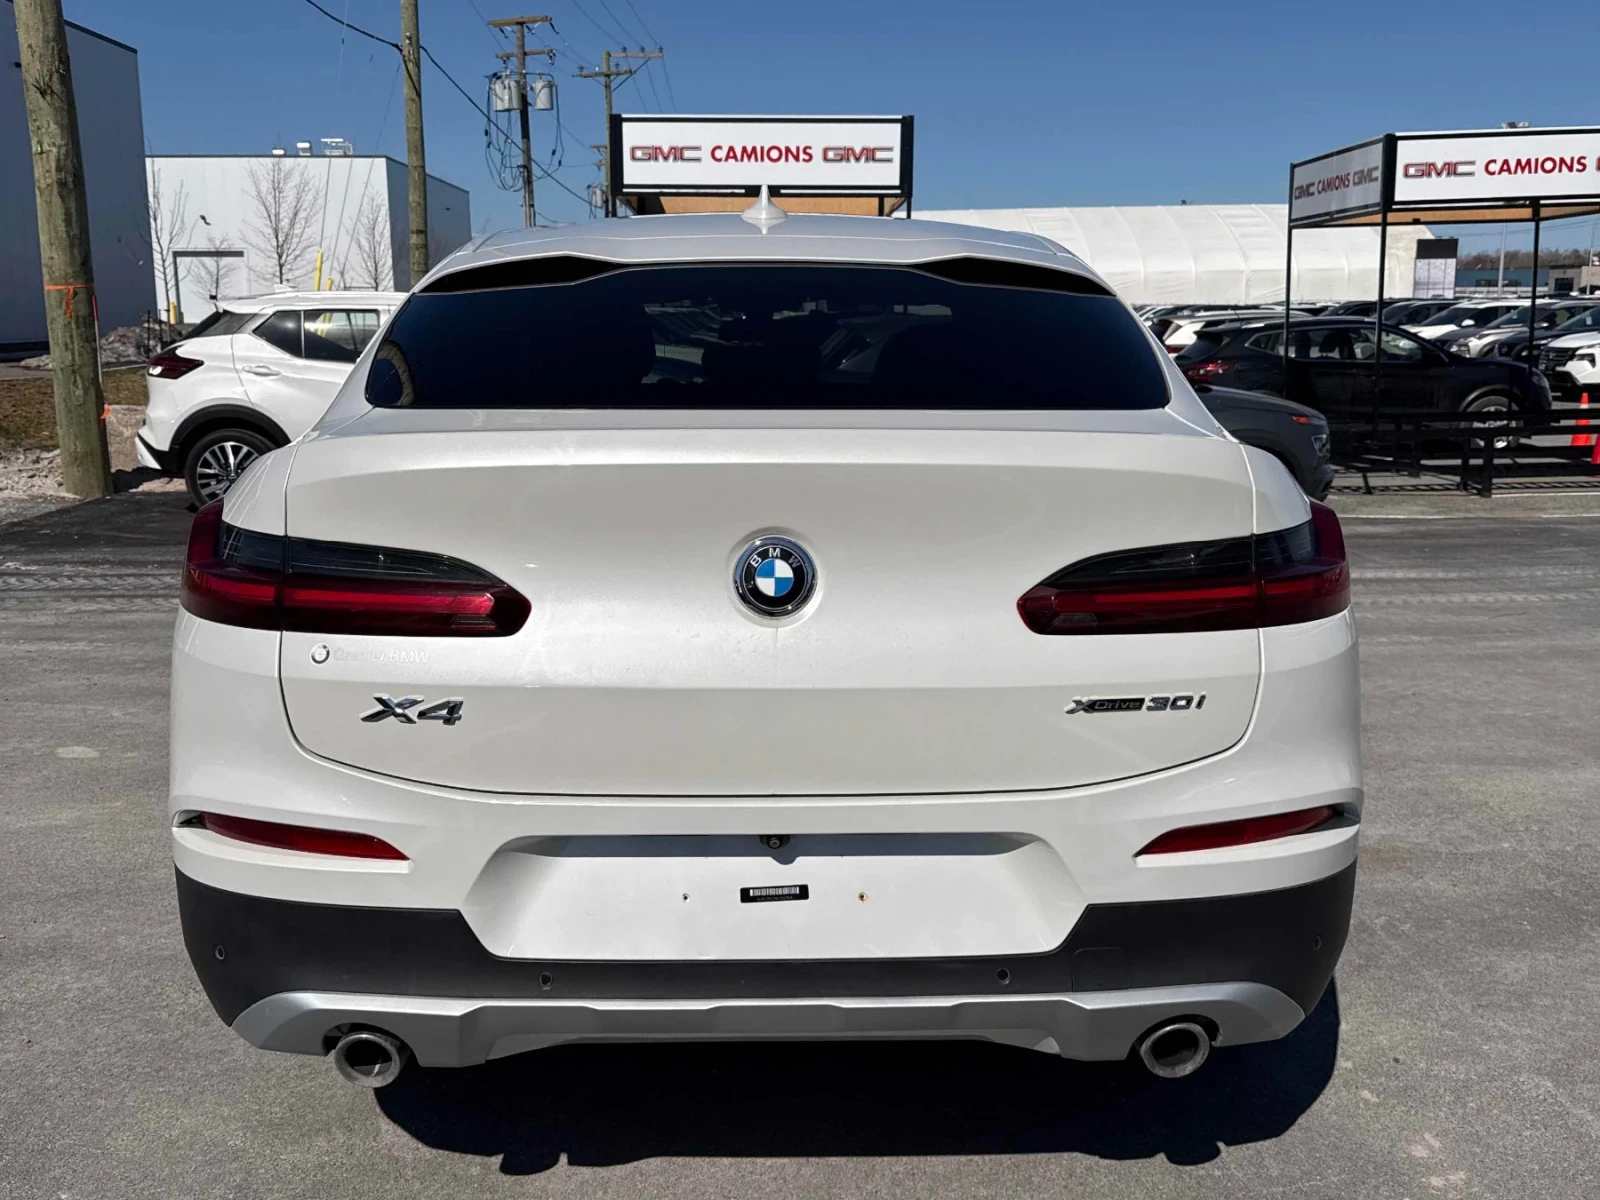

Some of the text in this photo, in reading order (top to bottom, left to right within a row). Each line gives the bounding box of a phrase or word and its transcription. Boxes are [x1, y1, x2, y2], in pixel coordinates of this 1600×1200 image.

[630, 145, 893, 163] GMC CAMIONS GMC
[1403, 160, 1475, 179] GMC
[1484, 156, 1587, 176] CAMIONS
[1294, 165, 1379, 200] GMC CAMIONS GMC
[750, 548, 801, 568] BMW
[389, 648, 430, 664] BMW
[359, 693, 463, 726] X4
